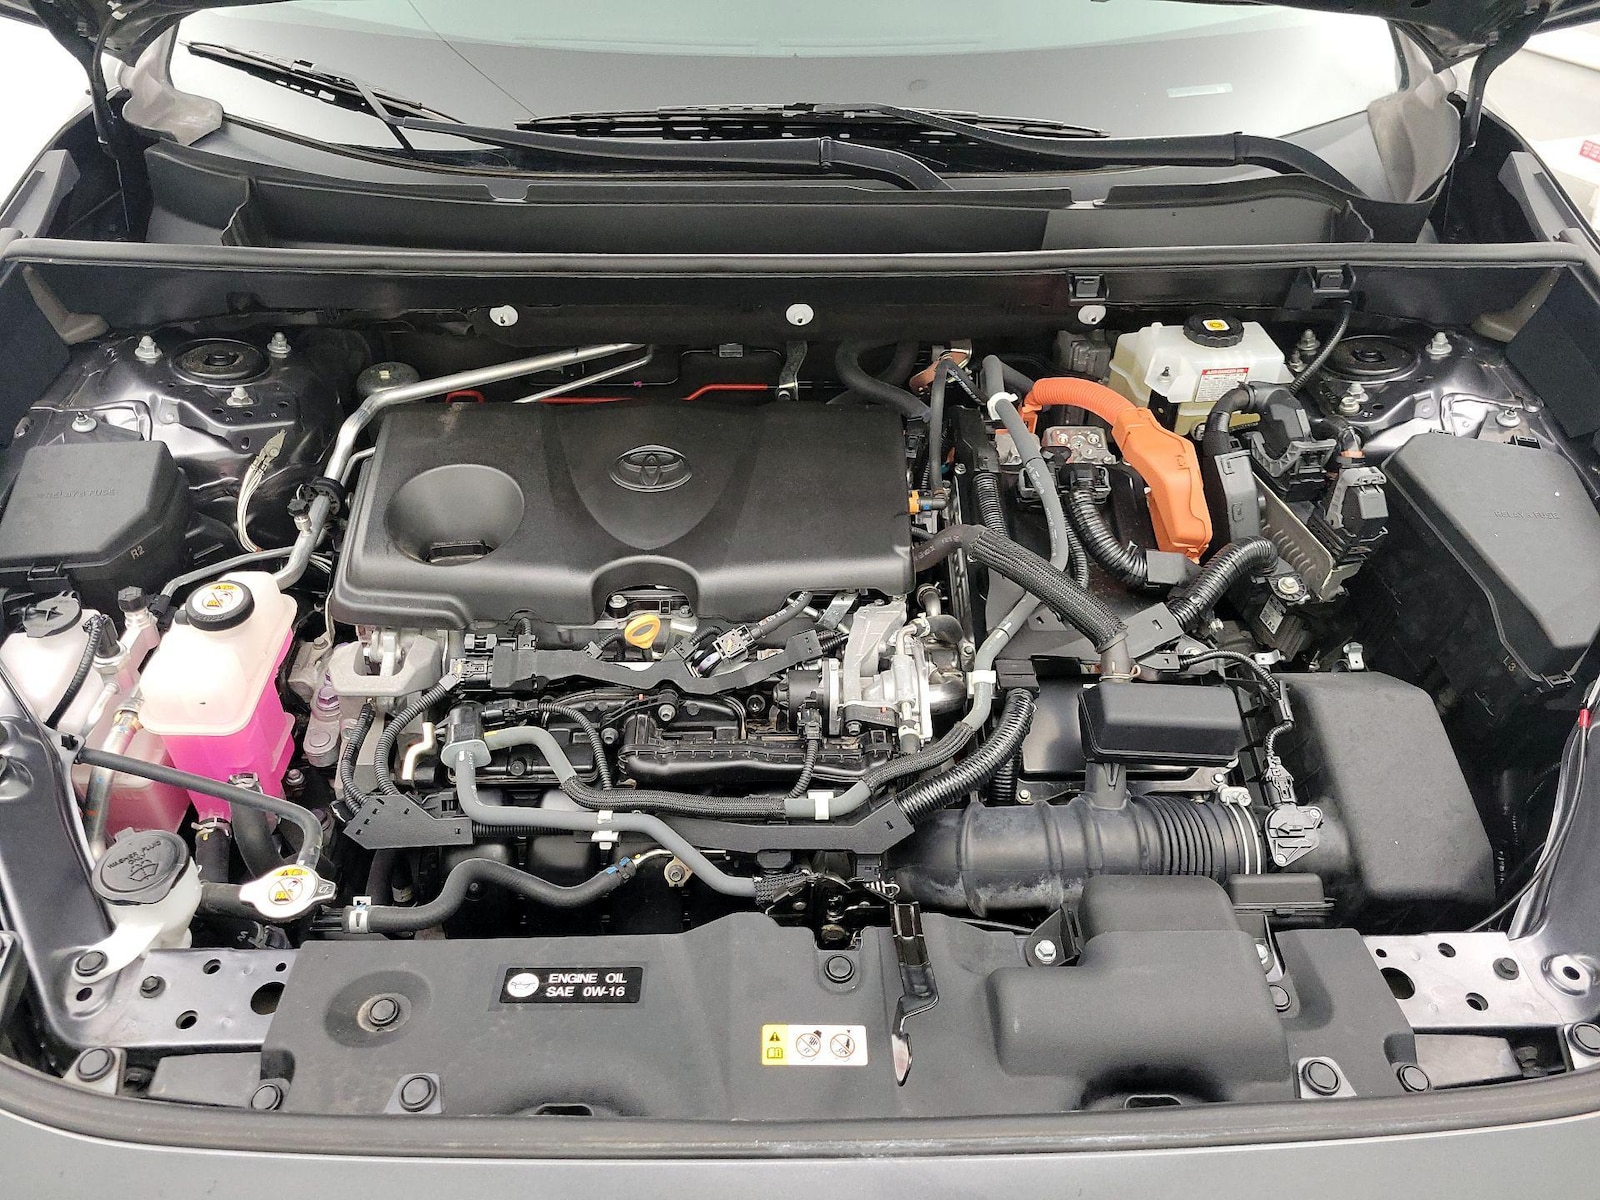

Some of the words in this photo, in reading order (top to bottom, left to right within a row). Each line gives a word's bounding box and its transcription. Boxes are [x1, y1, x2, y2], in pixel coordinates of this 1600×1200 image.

[130, 545, 145, 560] R2
[548, 973, 598, 983] ENGINE
[605, 973, 627, 983] OIL
[546, 986, 575, 997] SAE
[583, 986, 625, 997] 0W-16
